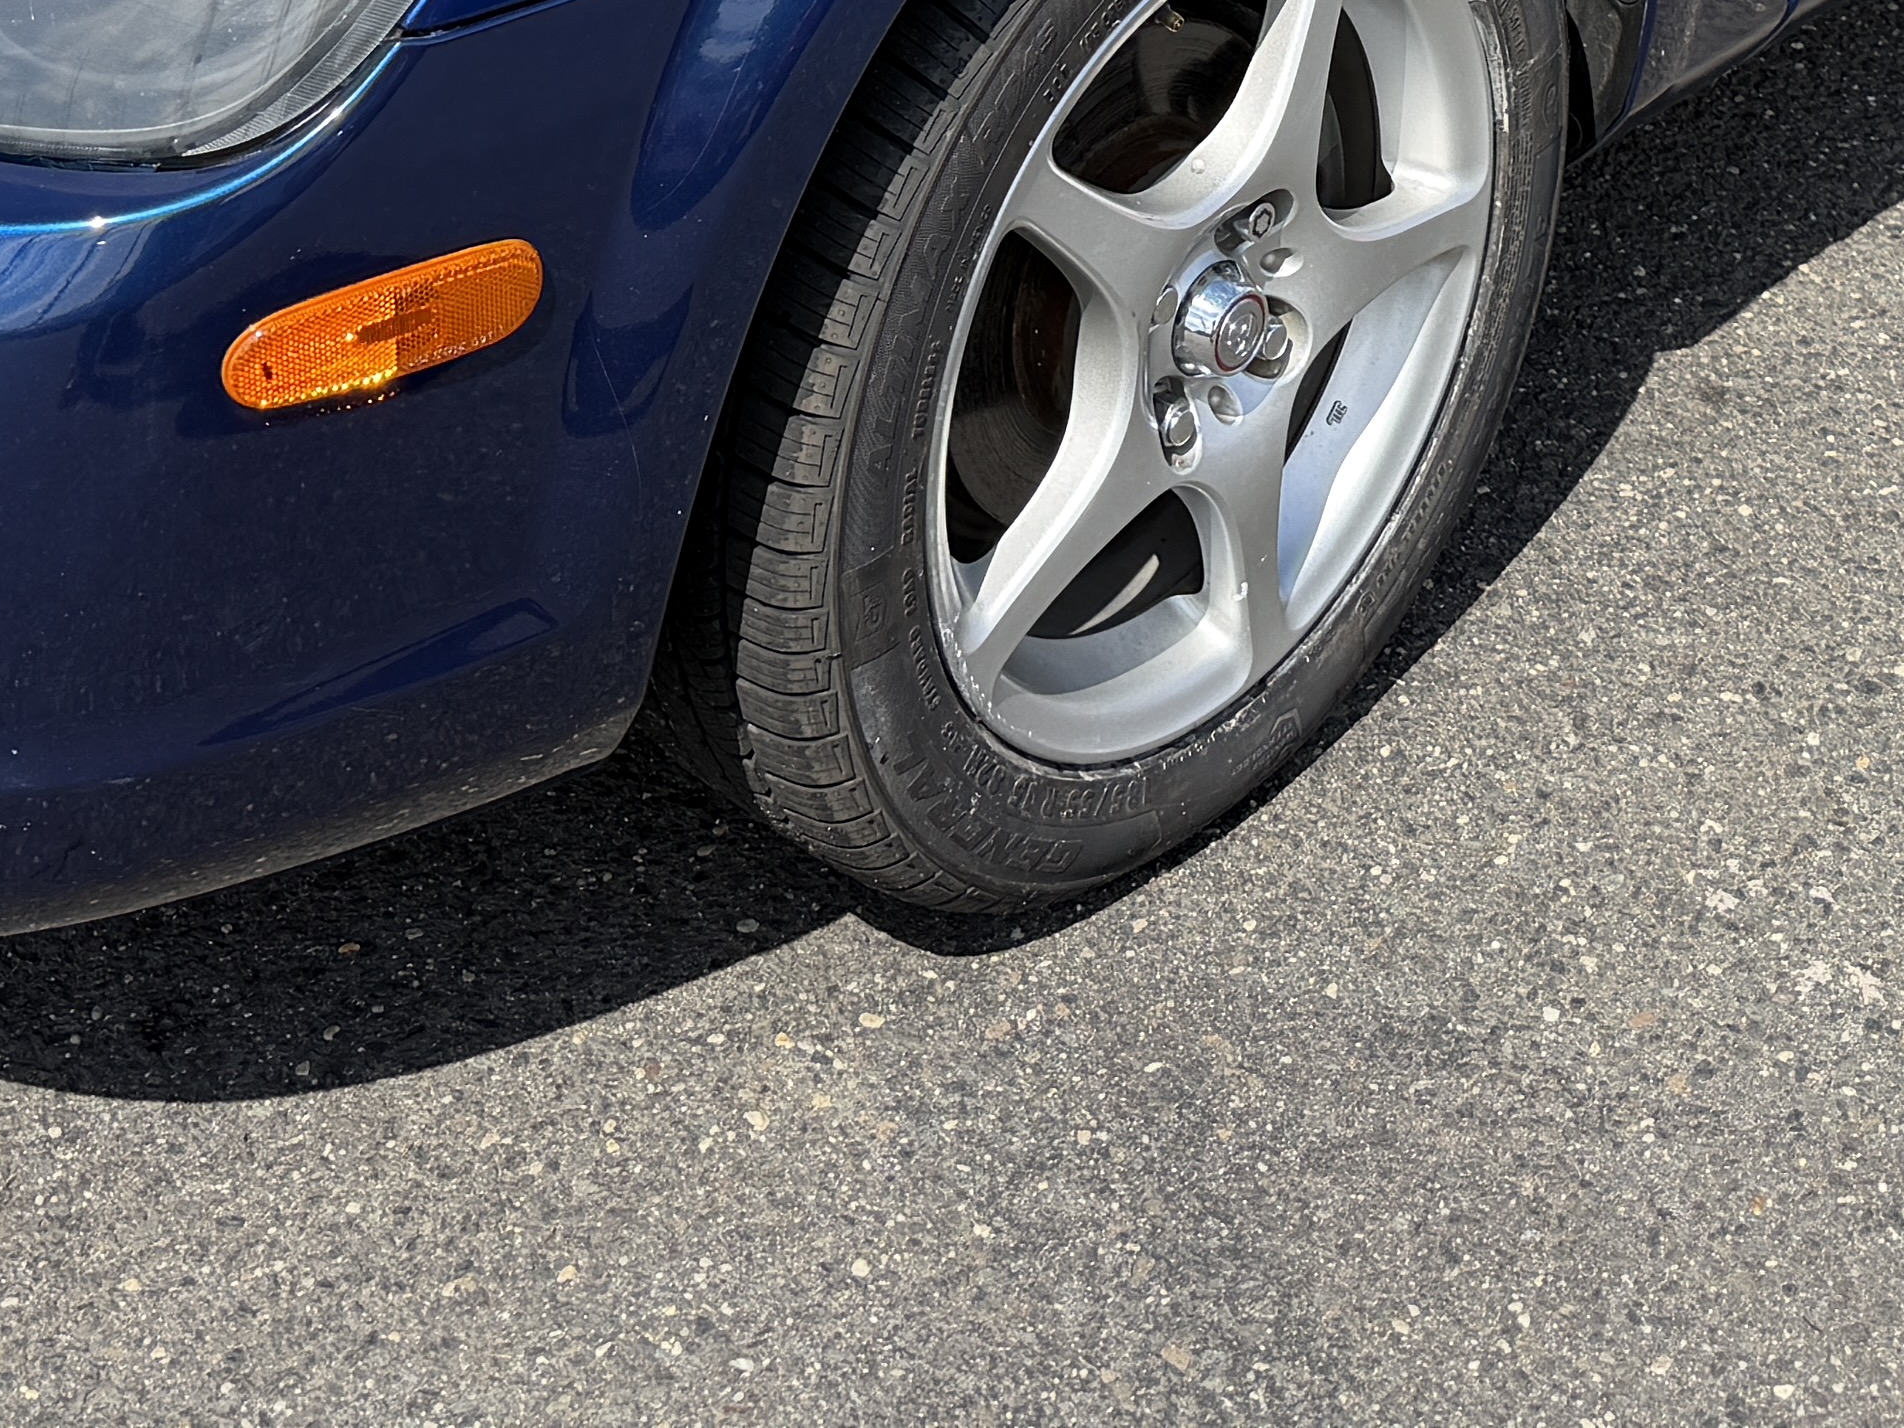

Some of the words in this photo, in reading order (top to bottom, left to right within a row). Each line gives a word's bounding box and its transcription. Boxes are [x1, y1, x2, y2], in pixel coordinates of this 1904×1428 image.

[900, 464, 918, 549] RADIAL
[901, 566, 918, 619] LOAD
[907, 623, 942, 713] STANDARD
[893, 752, 1084, 874] GENERAL
